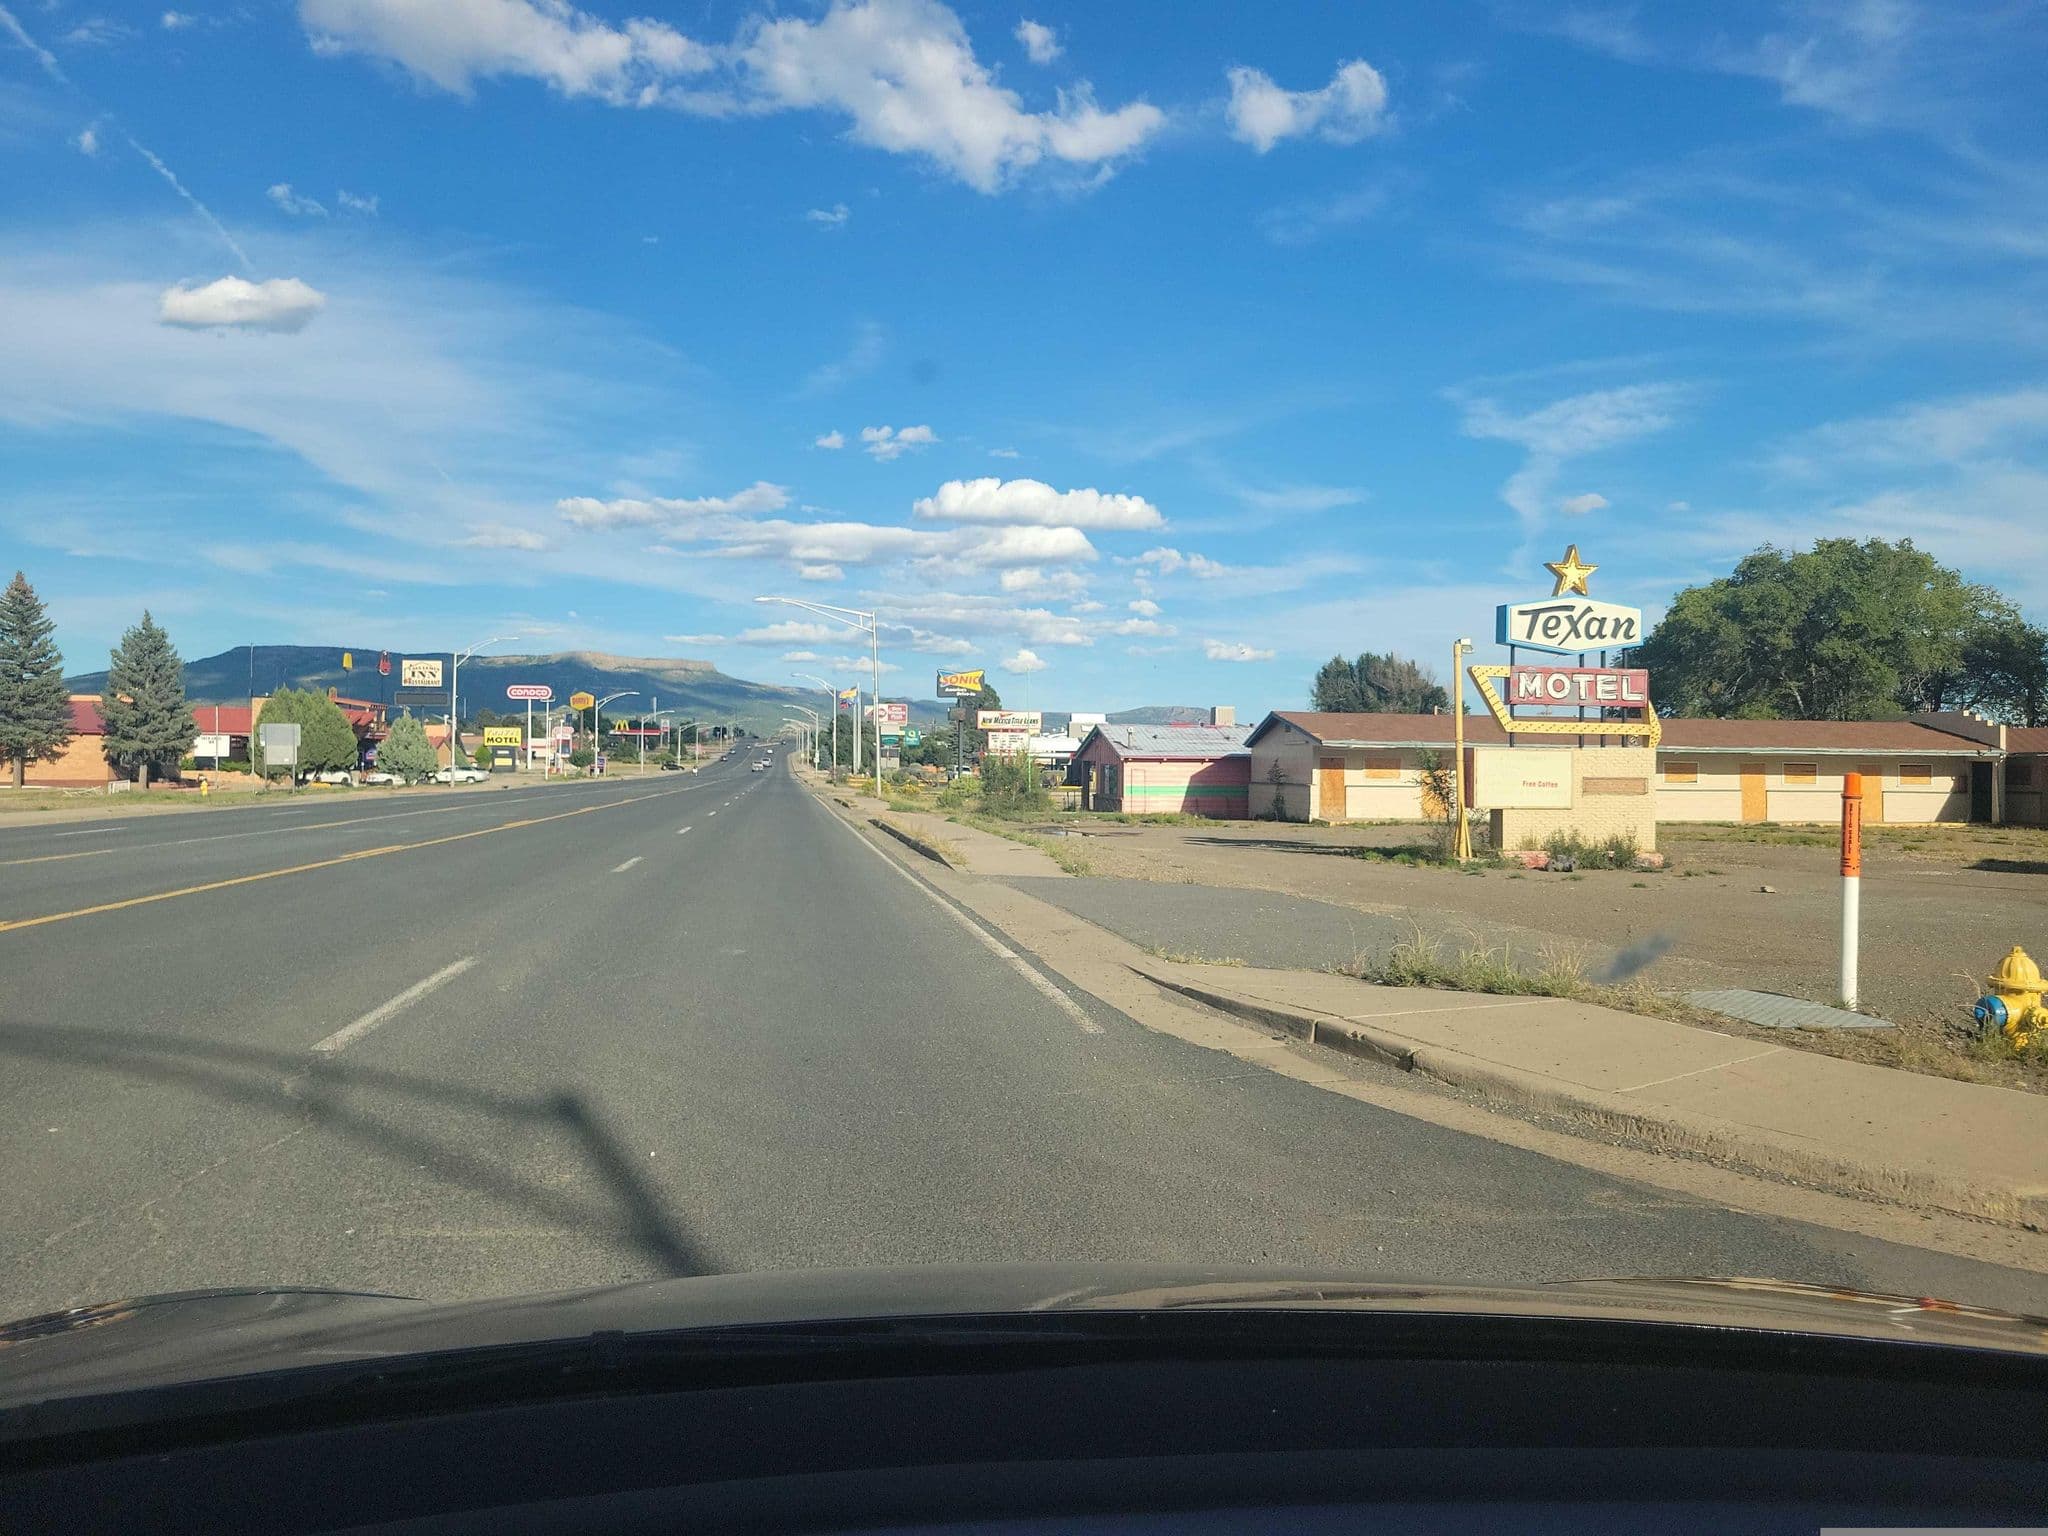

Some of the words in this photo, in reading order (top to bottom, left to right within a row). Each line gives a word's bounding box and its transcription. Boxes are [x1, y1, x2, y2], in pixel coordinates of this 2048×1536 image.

[1518, 605, 1636, 646] Texan
[942, 675, 979, 685] SONIC
[1518, 672, 1644, 701] MOTEL
